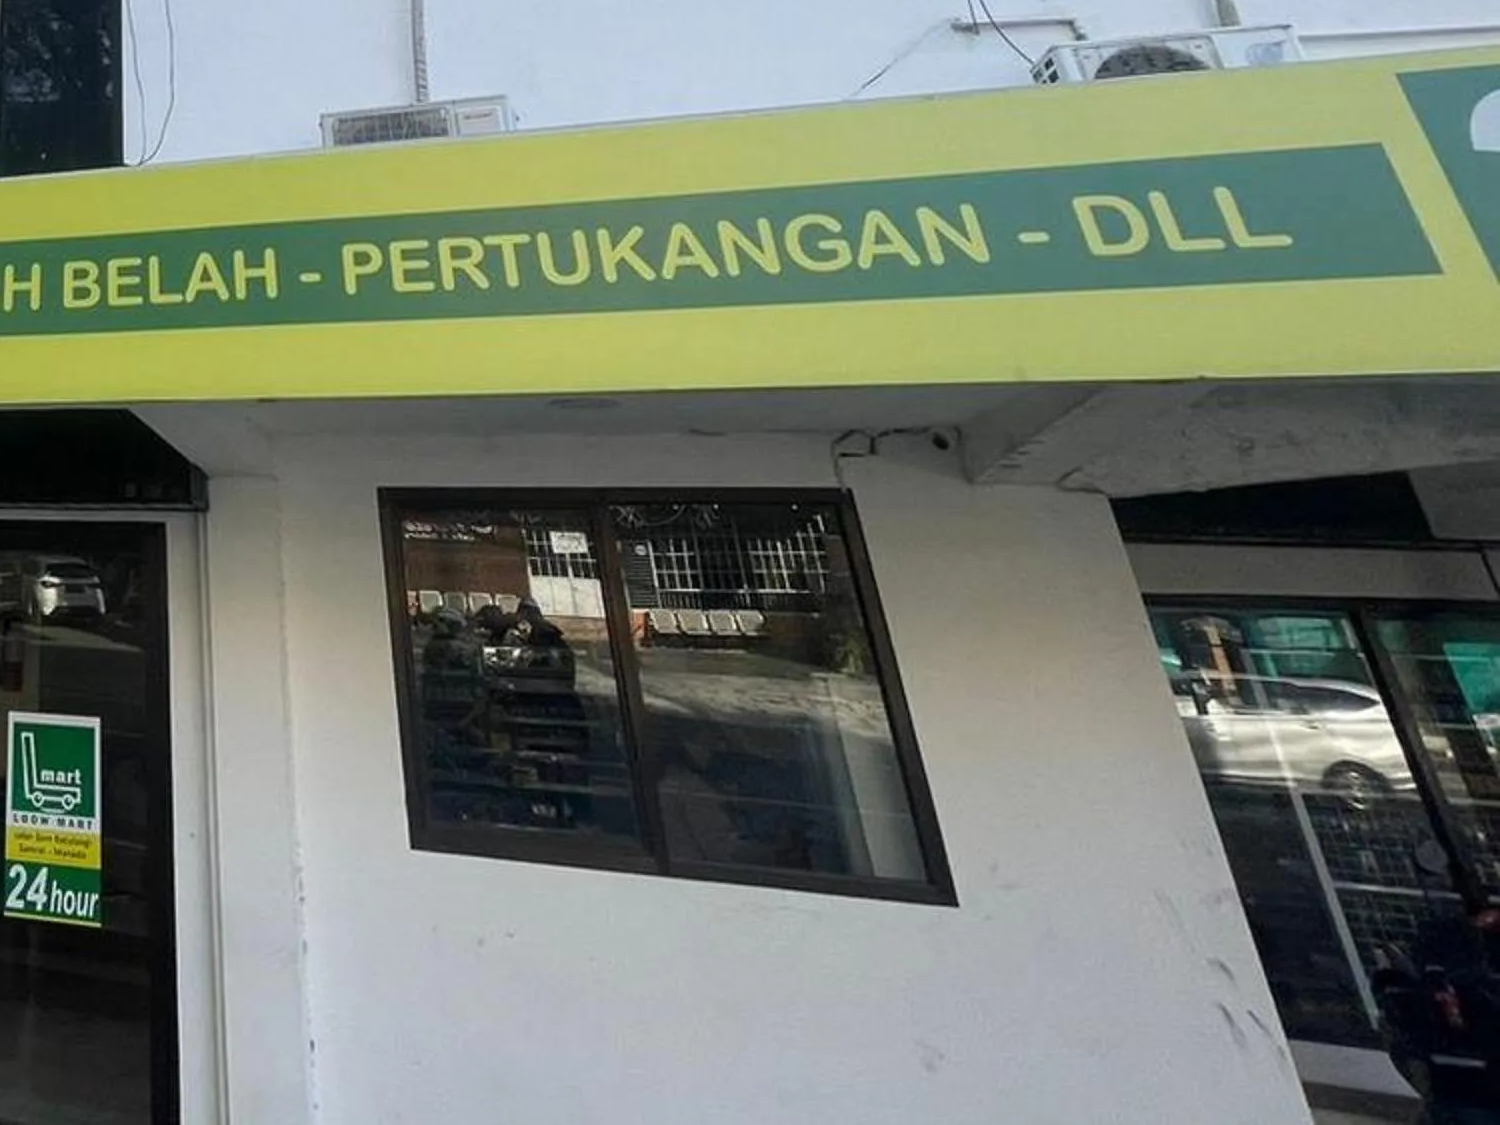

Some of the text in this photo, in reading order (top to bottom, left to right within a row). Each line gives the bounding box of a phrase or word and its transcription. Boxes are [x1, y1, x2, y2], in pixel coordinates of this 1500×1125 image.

[62, 247, 279, 310] BELAH
[340, 202, 992, 296] PERTUKANGAN
[1072, 185, 1293, 257] DLL
[57, 816, 94, 830] MART
[5, 863, 99, 918] 24 hour
